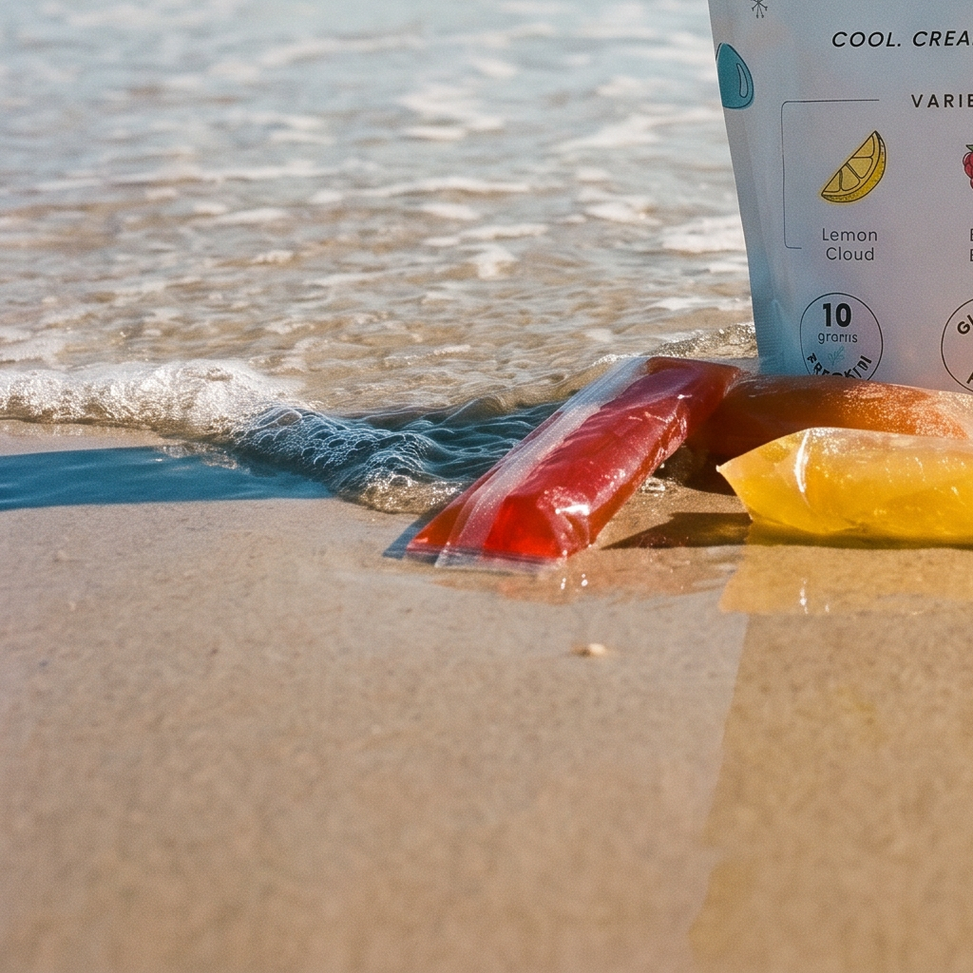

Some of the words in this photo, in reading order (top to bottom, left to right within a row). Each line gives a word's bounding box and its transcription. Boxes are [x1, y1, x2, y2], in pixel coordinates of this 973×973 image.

[831, 30, 902, 48] COOL.
[822, 227, 878, 243] Lemon
[825, 246, 875, 262] Cloud
[822, 302, 852, 328] 10
